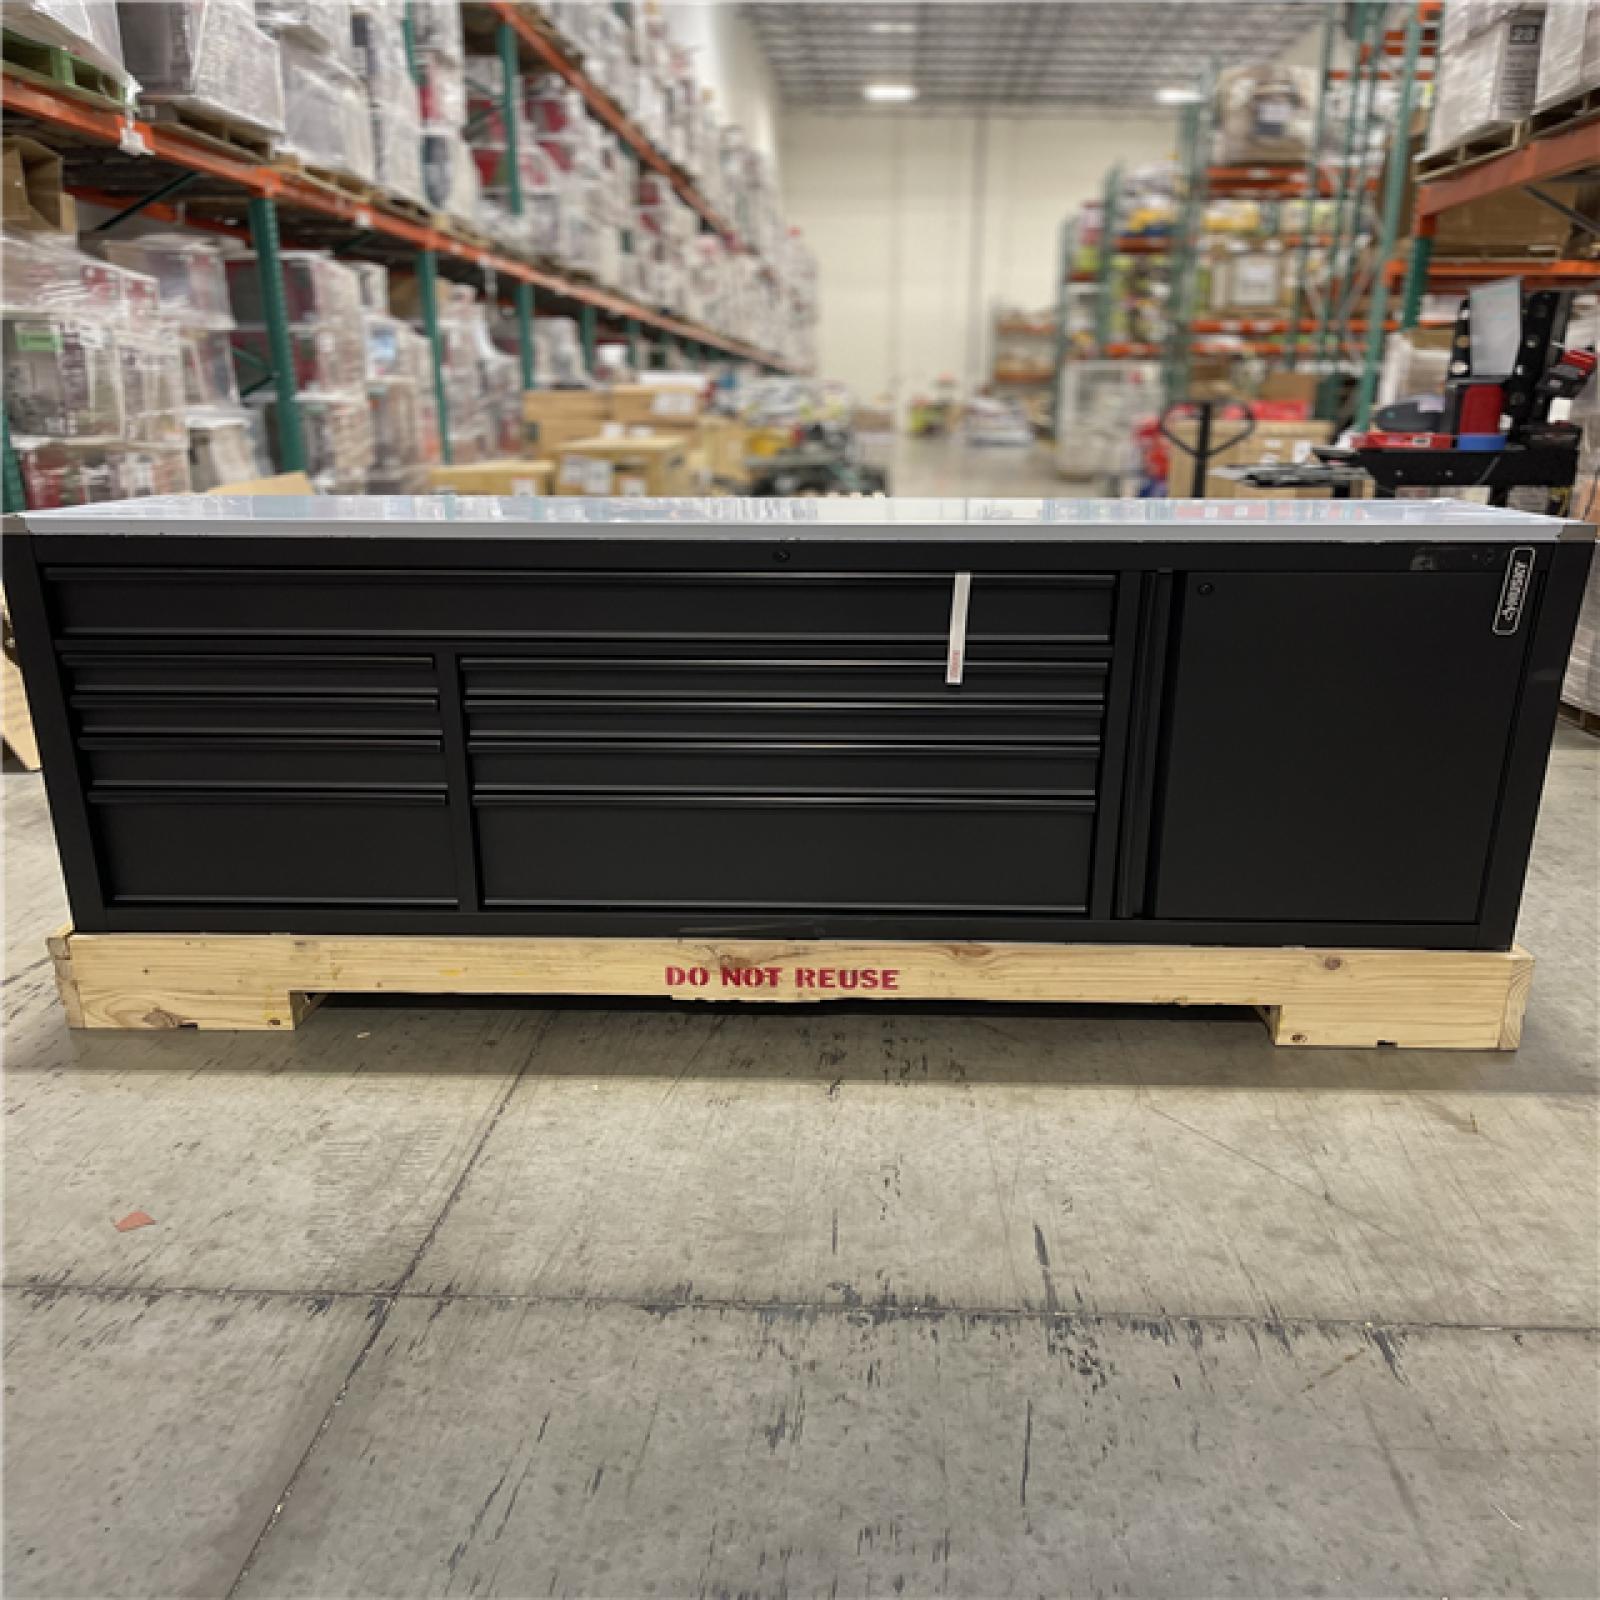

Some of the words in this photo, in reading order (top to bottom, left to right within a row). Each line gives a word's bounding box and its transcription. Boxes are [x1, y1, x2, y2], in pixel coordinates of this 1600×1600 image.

[666, 966, 710, 986] DO
[721, 966, 783, 987] NOT
[795, 967, 899, 990] REUSE
